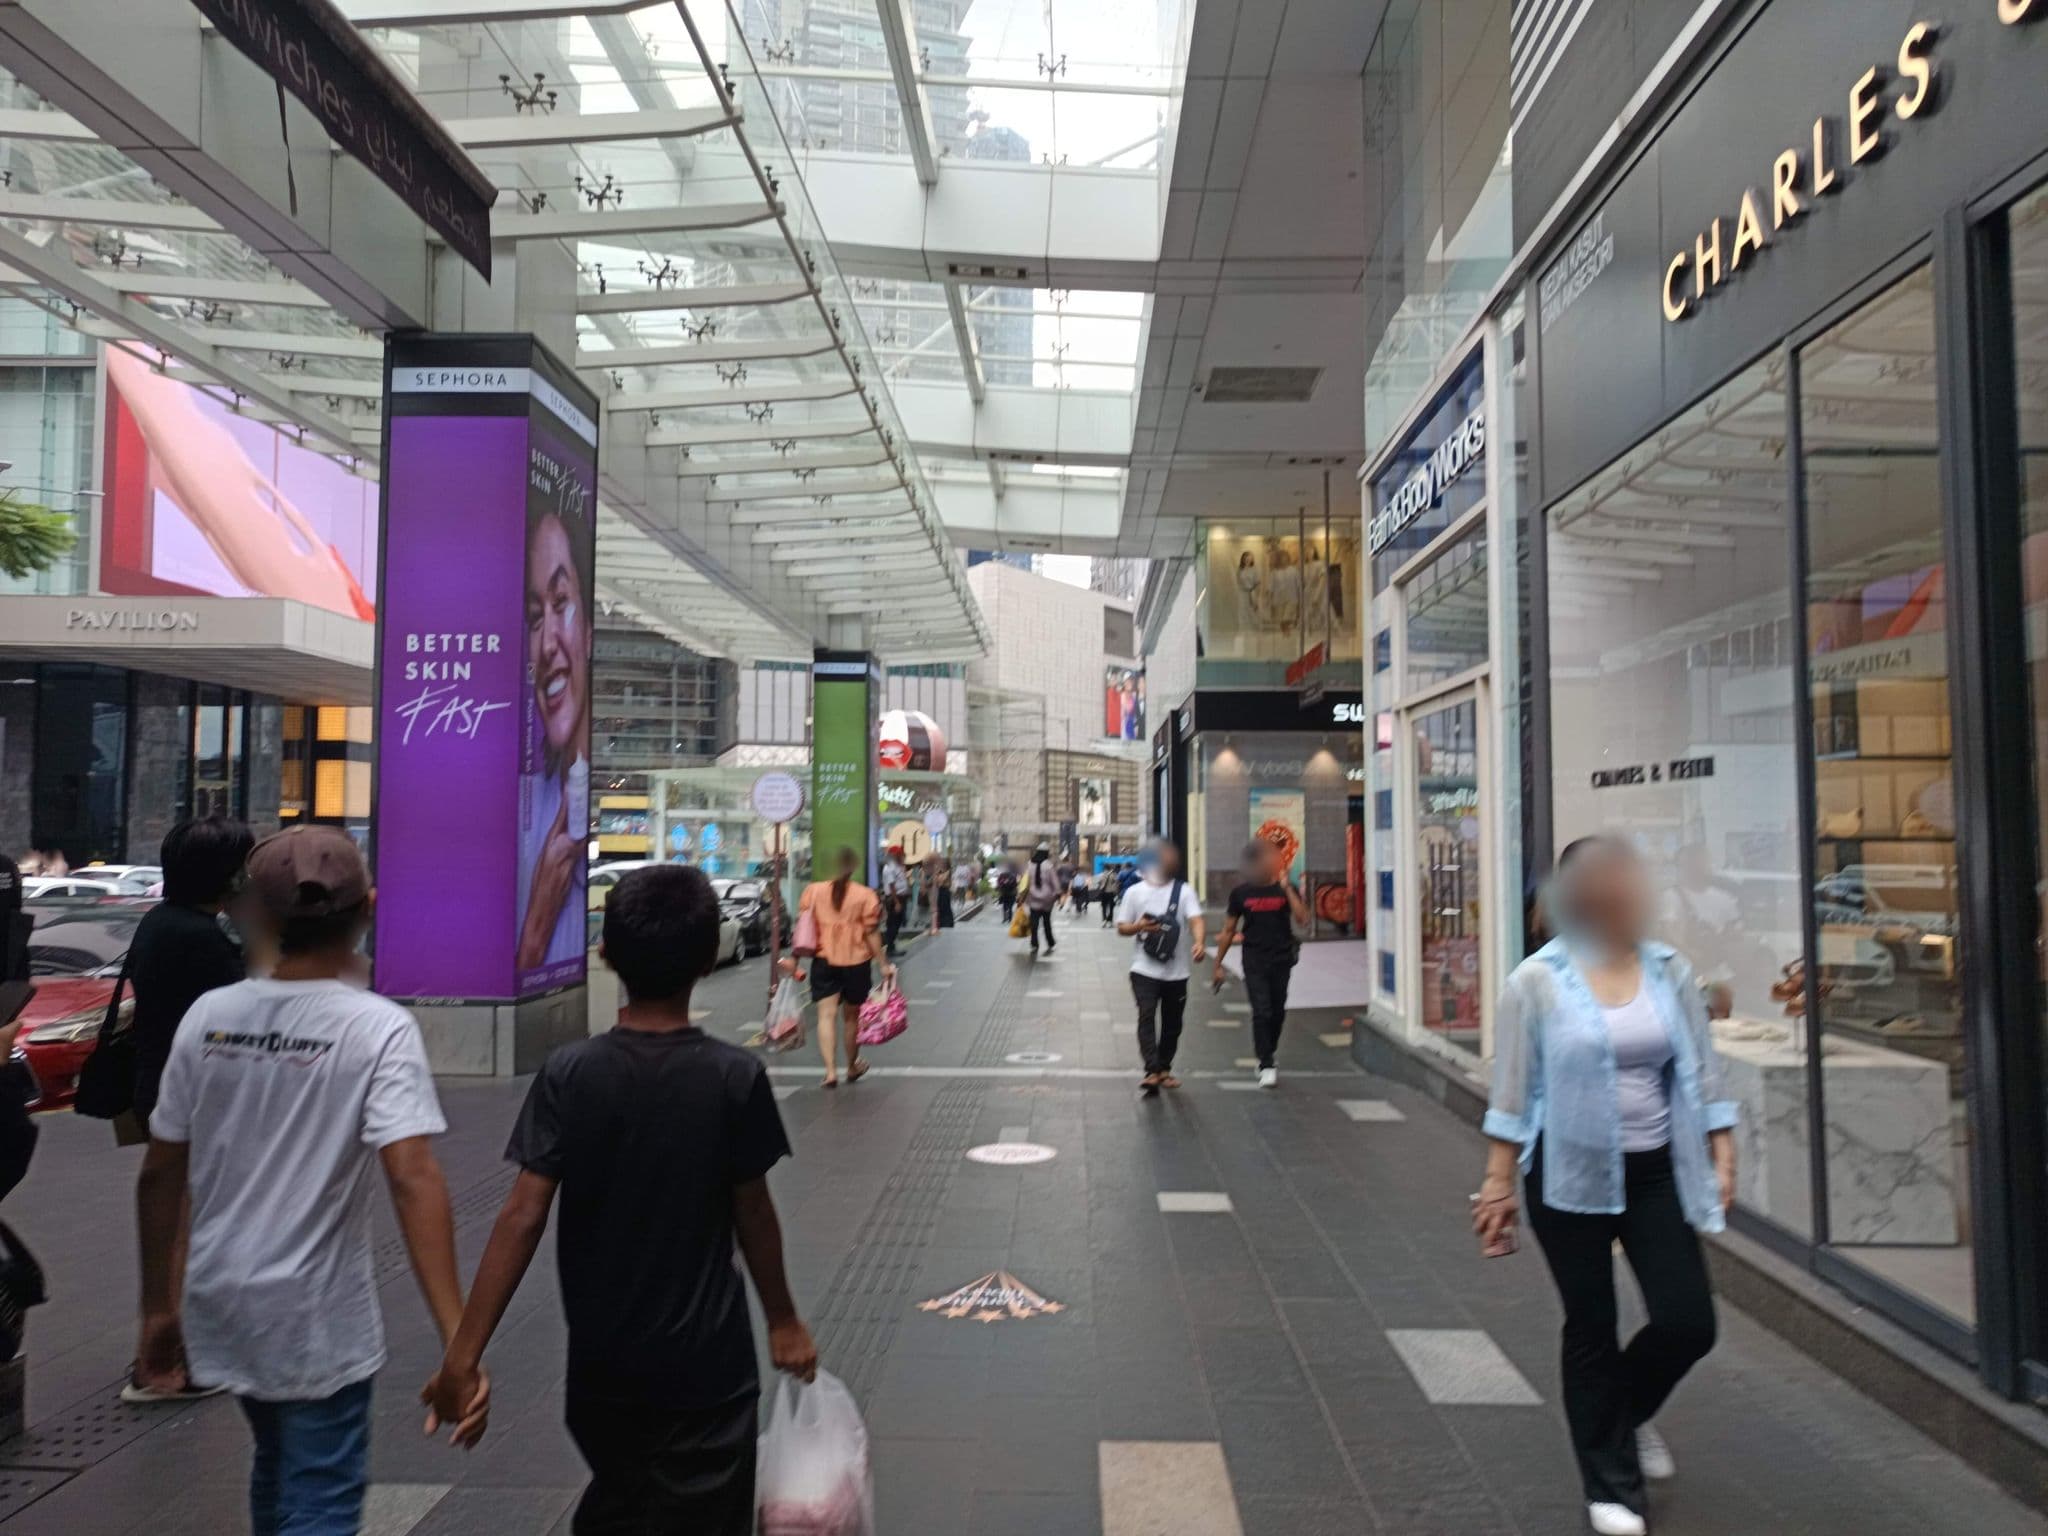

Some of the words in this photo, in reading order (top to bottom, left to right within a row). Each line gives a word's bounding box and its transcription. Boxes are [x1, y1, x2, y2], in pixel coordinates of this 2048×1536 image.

[1662, 20, 1932, 323] CHARLES
[416, 373, 508, 386] SEPHORA
[531, 447, 560, 478] BETTER
[531, 470, 551, 495] SKIN
[65, 609, 199, 631] PAVILION
[406, 633, 501, 653] BETTER
[404, 661, 471, 681] SKIN
[394, 683, 512, 746] FAST
